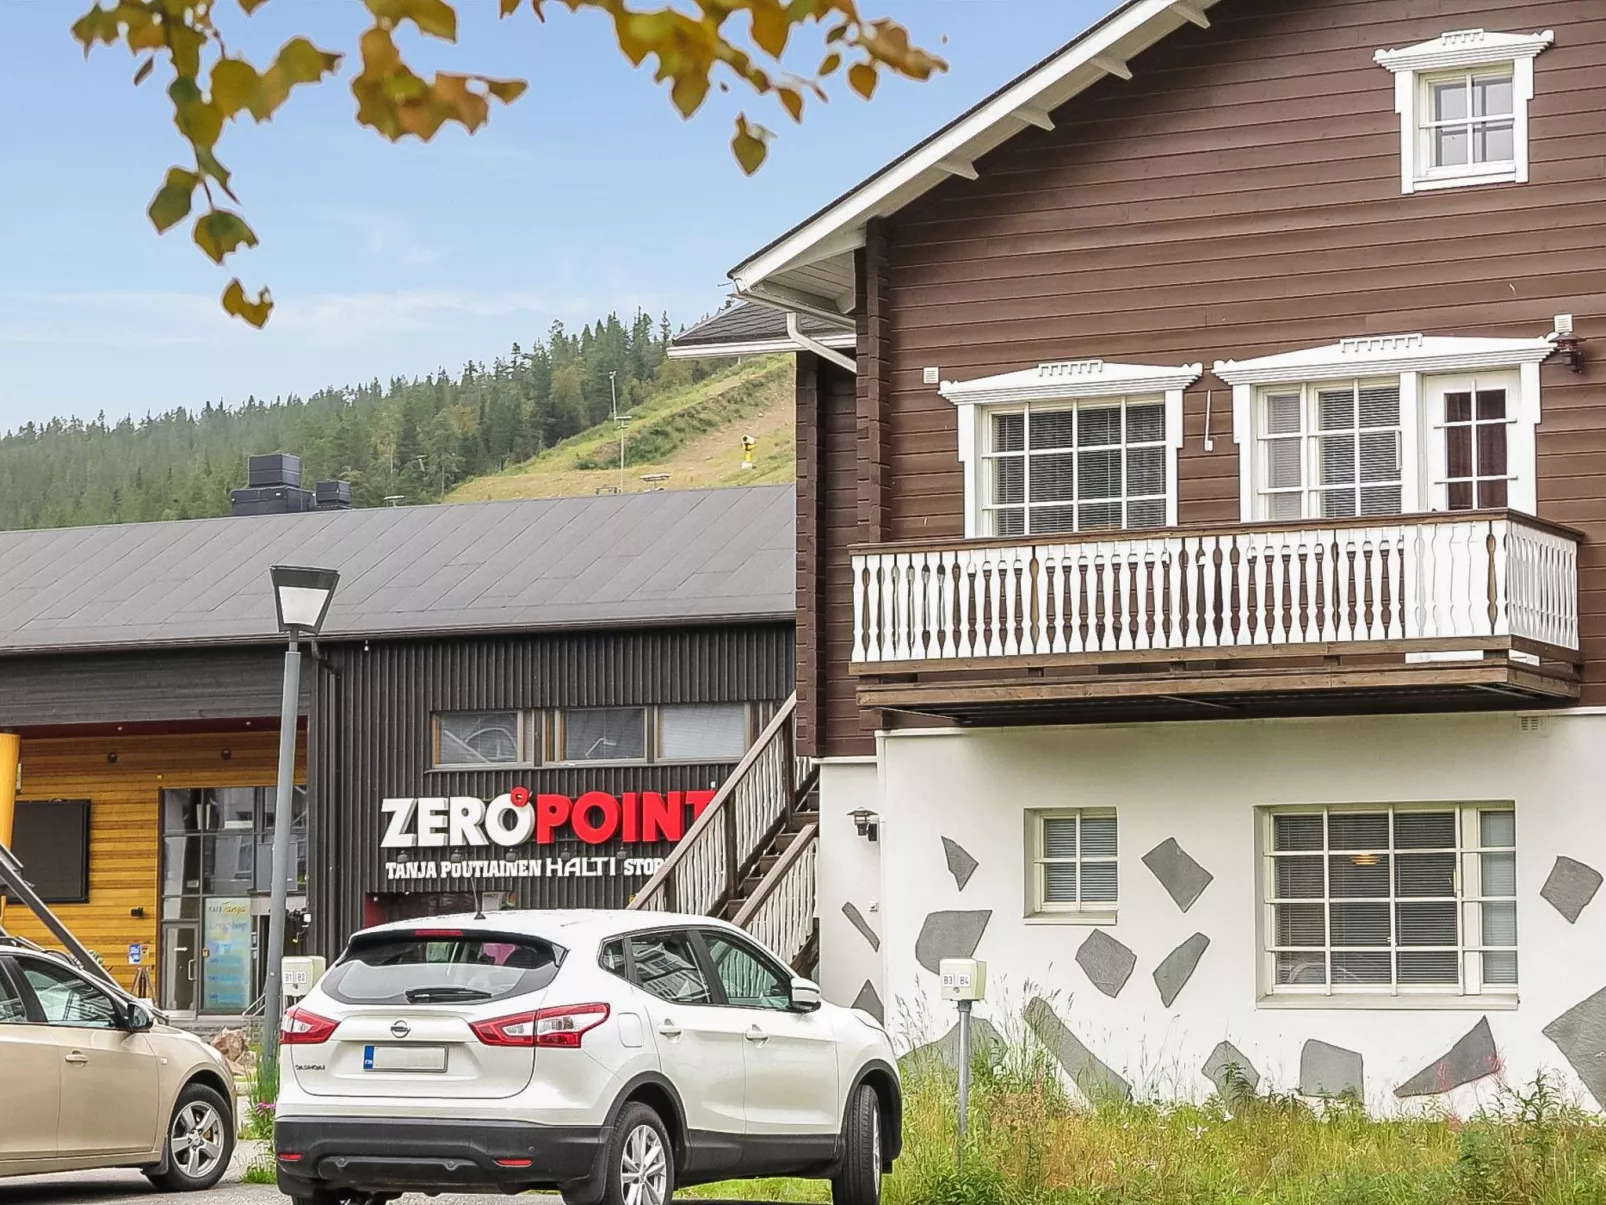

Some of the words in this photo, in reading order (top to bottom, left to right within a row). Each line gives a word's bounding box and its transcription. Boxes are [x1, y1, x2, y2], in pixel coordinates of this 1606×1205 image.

[385, 860, 437, 880] TANJA
[440, 858, 542, 879] POUTIAINEN
[545, 857, 616, 877] HALTI
[623, 857, 670, 876] STOR
[943, 975, 953, 985] B3
[960, 976, 969, 985] B4
